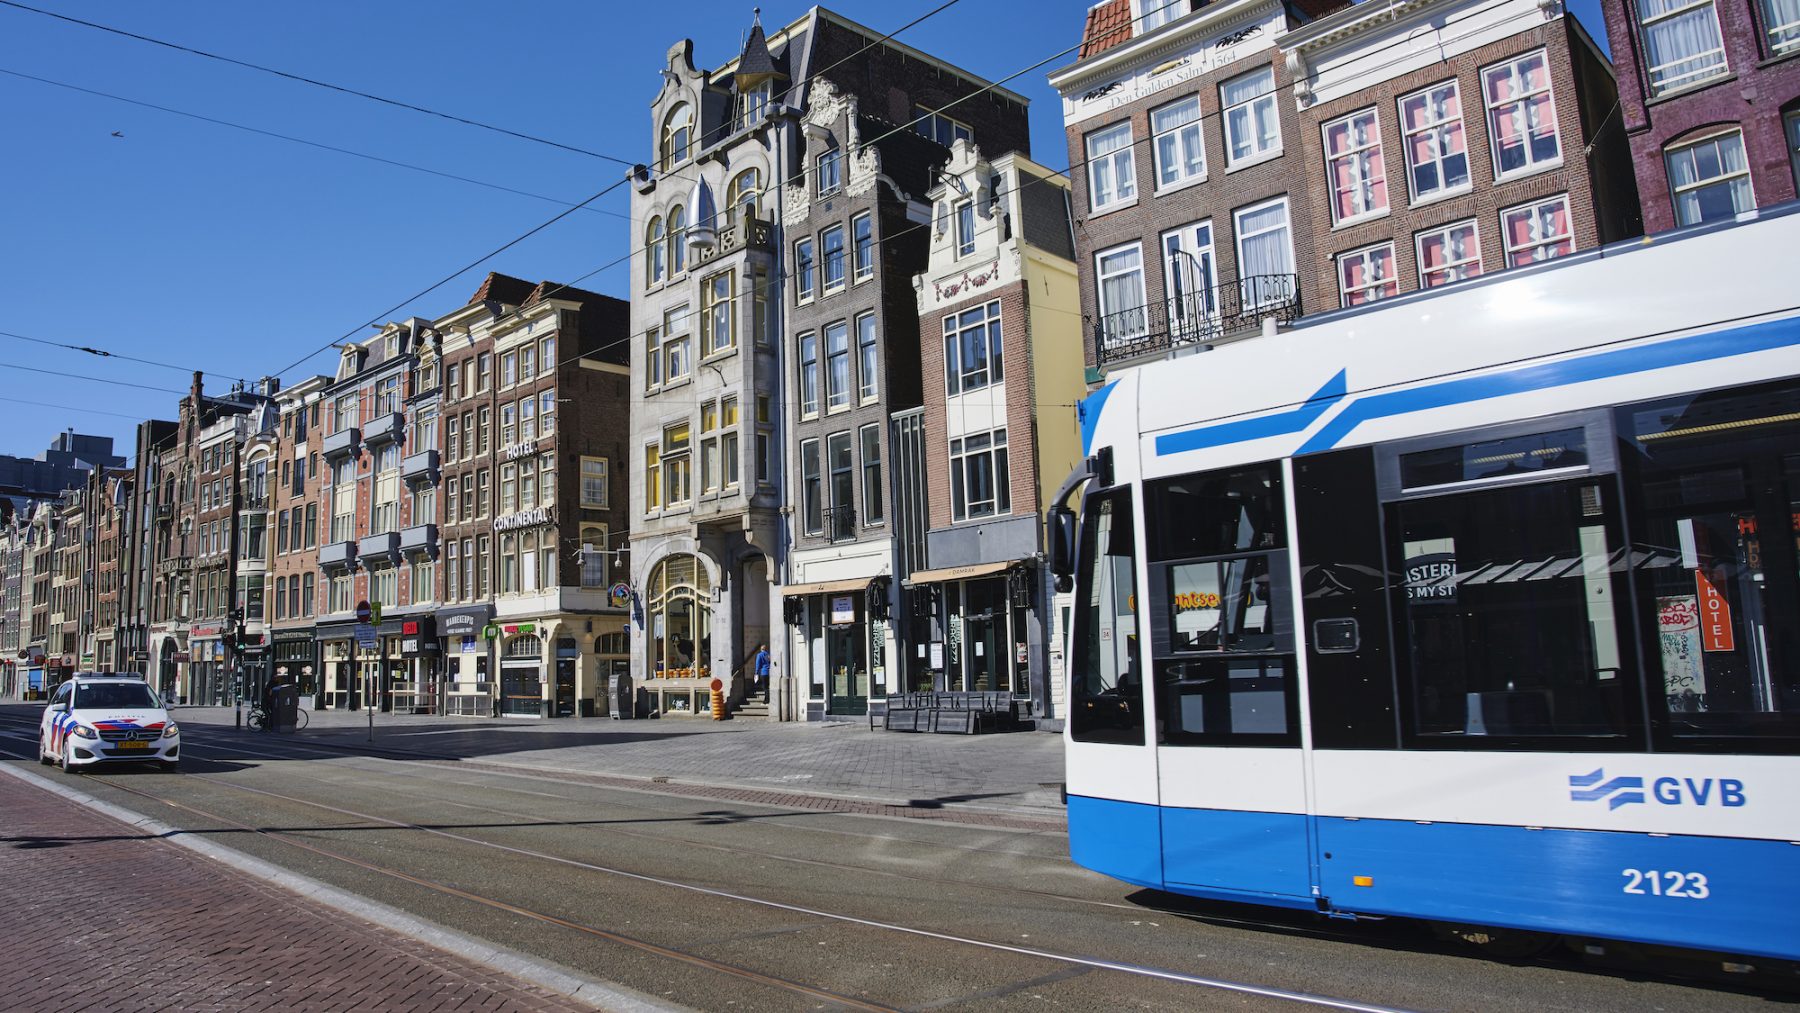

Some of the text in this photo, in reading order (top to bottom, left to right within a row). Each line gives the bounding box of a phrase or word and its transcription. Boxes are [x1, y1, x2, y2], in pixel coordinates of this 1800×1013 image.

[1211, 50, 1236, 69] 1564
[506, 441, 534, 460] HOTEL
[493, 509, 548, 531] CONTINENTAL
[1438, 584, 1457, 596] ST
[1706, 586, 1724, 649] HOTEL
[402, 639, 418, 653] HOTEL
[1653, 776, 1747, 807] GVB
[1622, 868, 1710, 899] 2123
